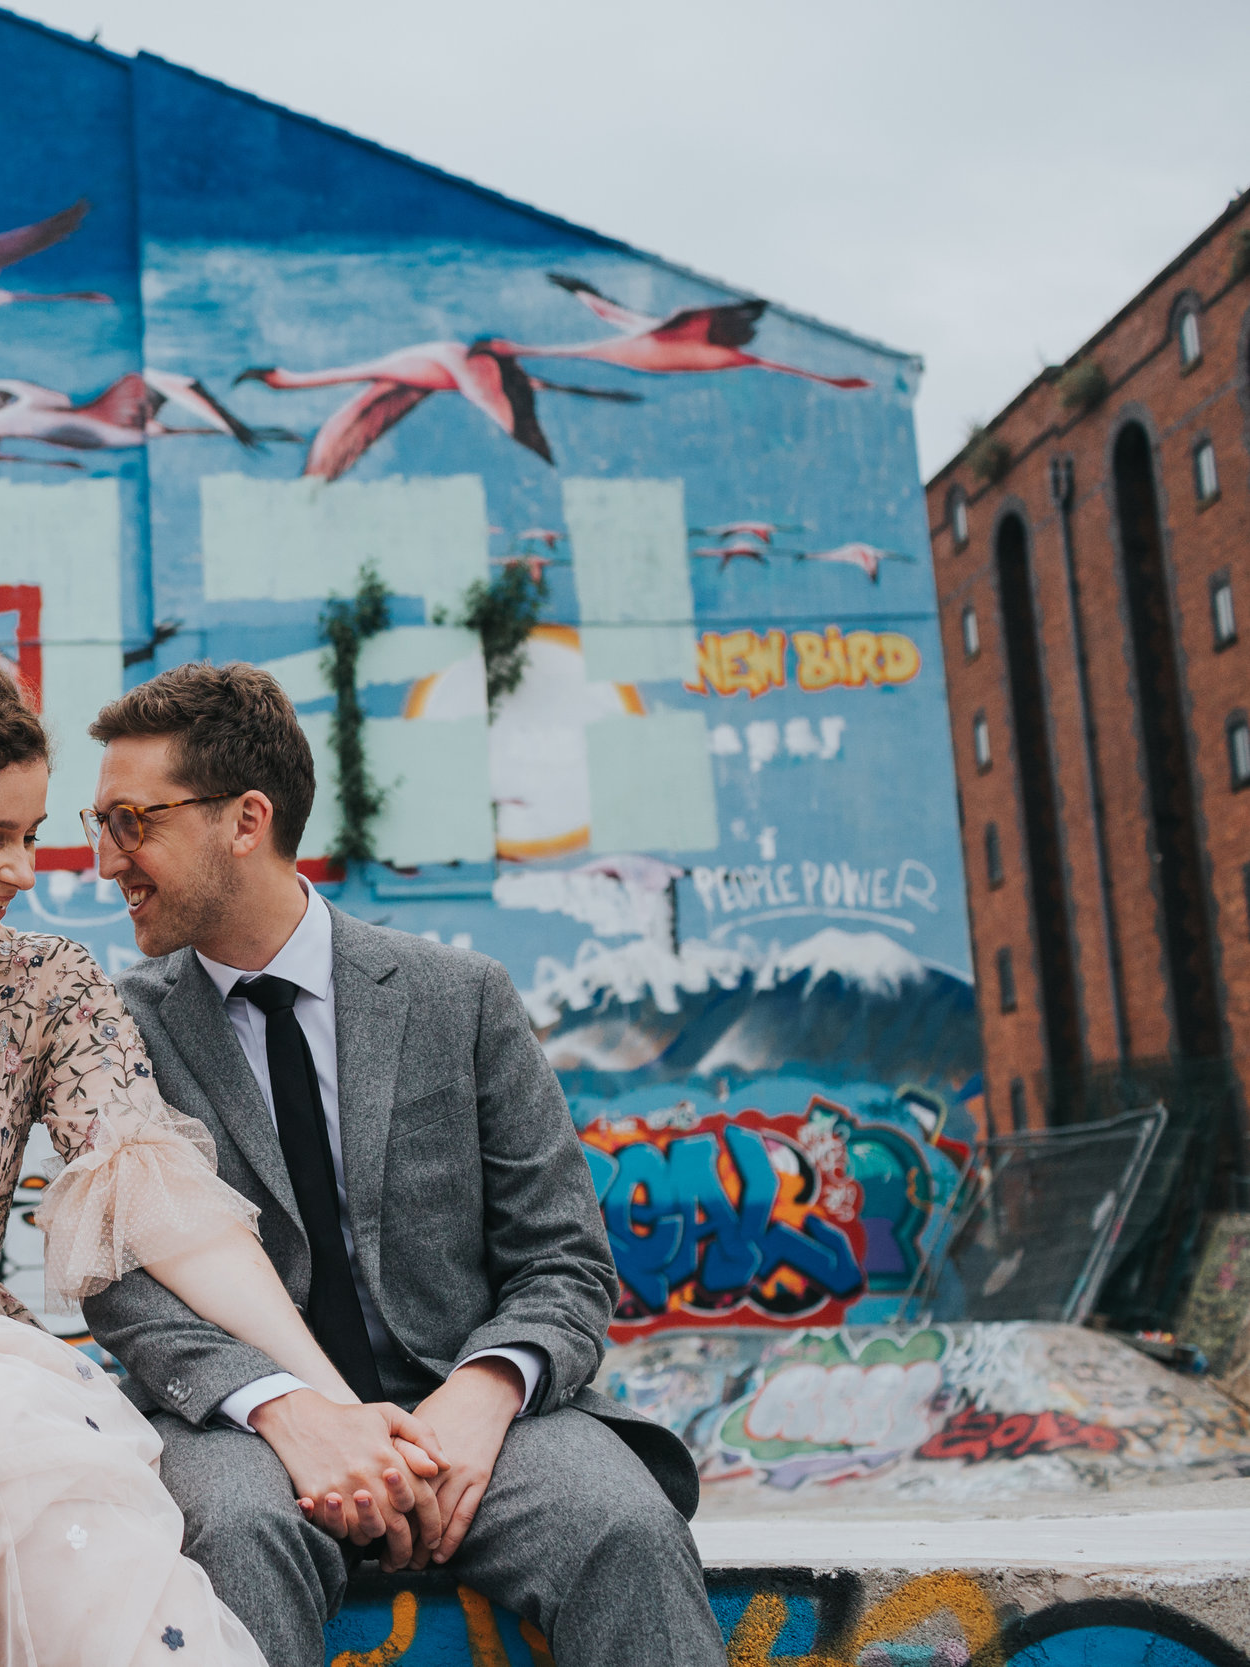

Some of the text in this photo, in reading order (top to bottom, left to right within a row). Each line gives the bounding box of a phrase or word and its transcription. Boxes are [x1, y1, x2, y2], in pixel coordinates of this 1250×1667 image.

[684, 627, 787, 699] NEW
[692, 859, 940, 914] PEOPLE POWER
